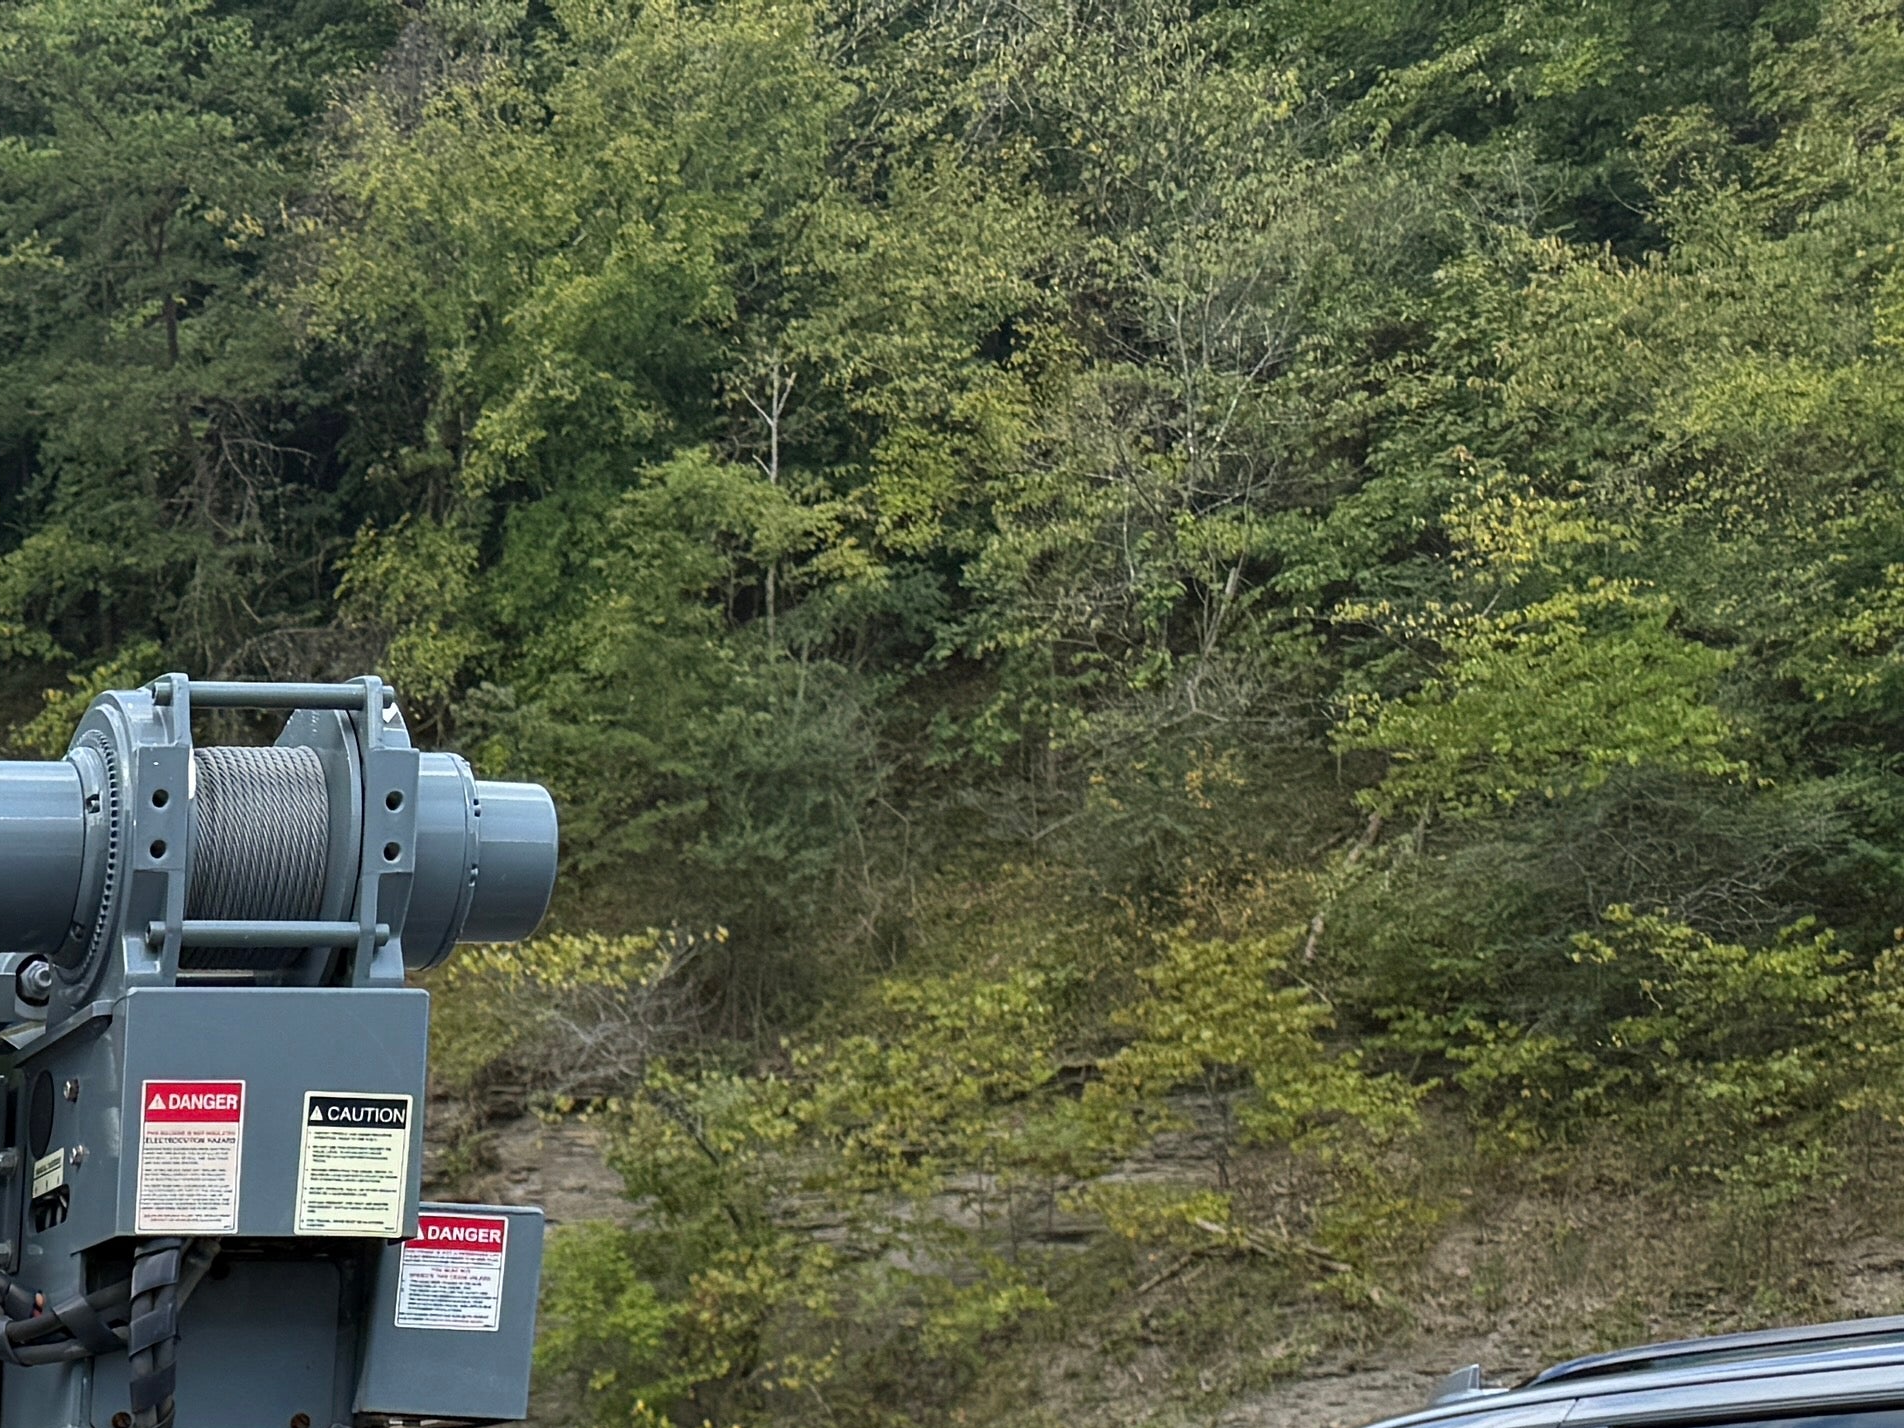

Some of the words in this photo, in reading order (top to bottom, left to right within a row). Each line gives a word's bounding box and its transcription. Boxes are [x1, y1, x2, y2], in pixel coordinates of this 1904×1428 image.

[168, 1093, 239, 1110] DANGER
[327, 1105, 406, 1124] CAUTION
[427, 1225, 502, 1244] DANGER
